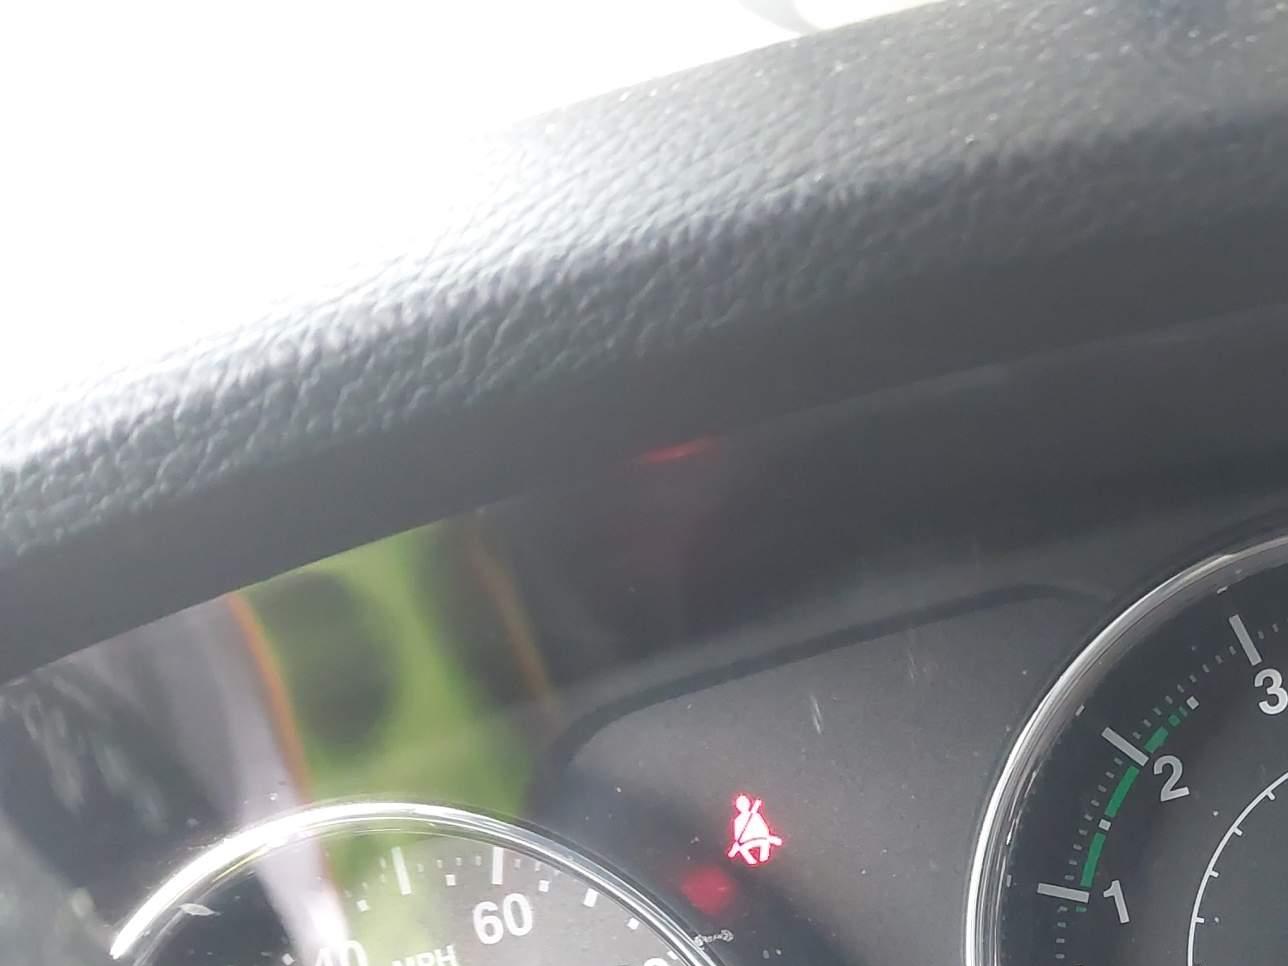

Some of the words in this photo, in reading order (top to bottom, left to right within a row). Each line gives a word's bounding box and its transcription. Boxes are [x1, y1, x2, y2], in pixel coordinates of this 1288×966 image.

[1256, 668, 1288, 714] 3
[1153, 756, 1190, 802] 2
[473, 893, 533, 945] 60
[1103, 881, 1131, 924] 1
